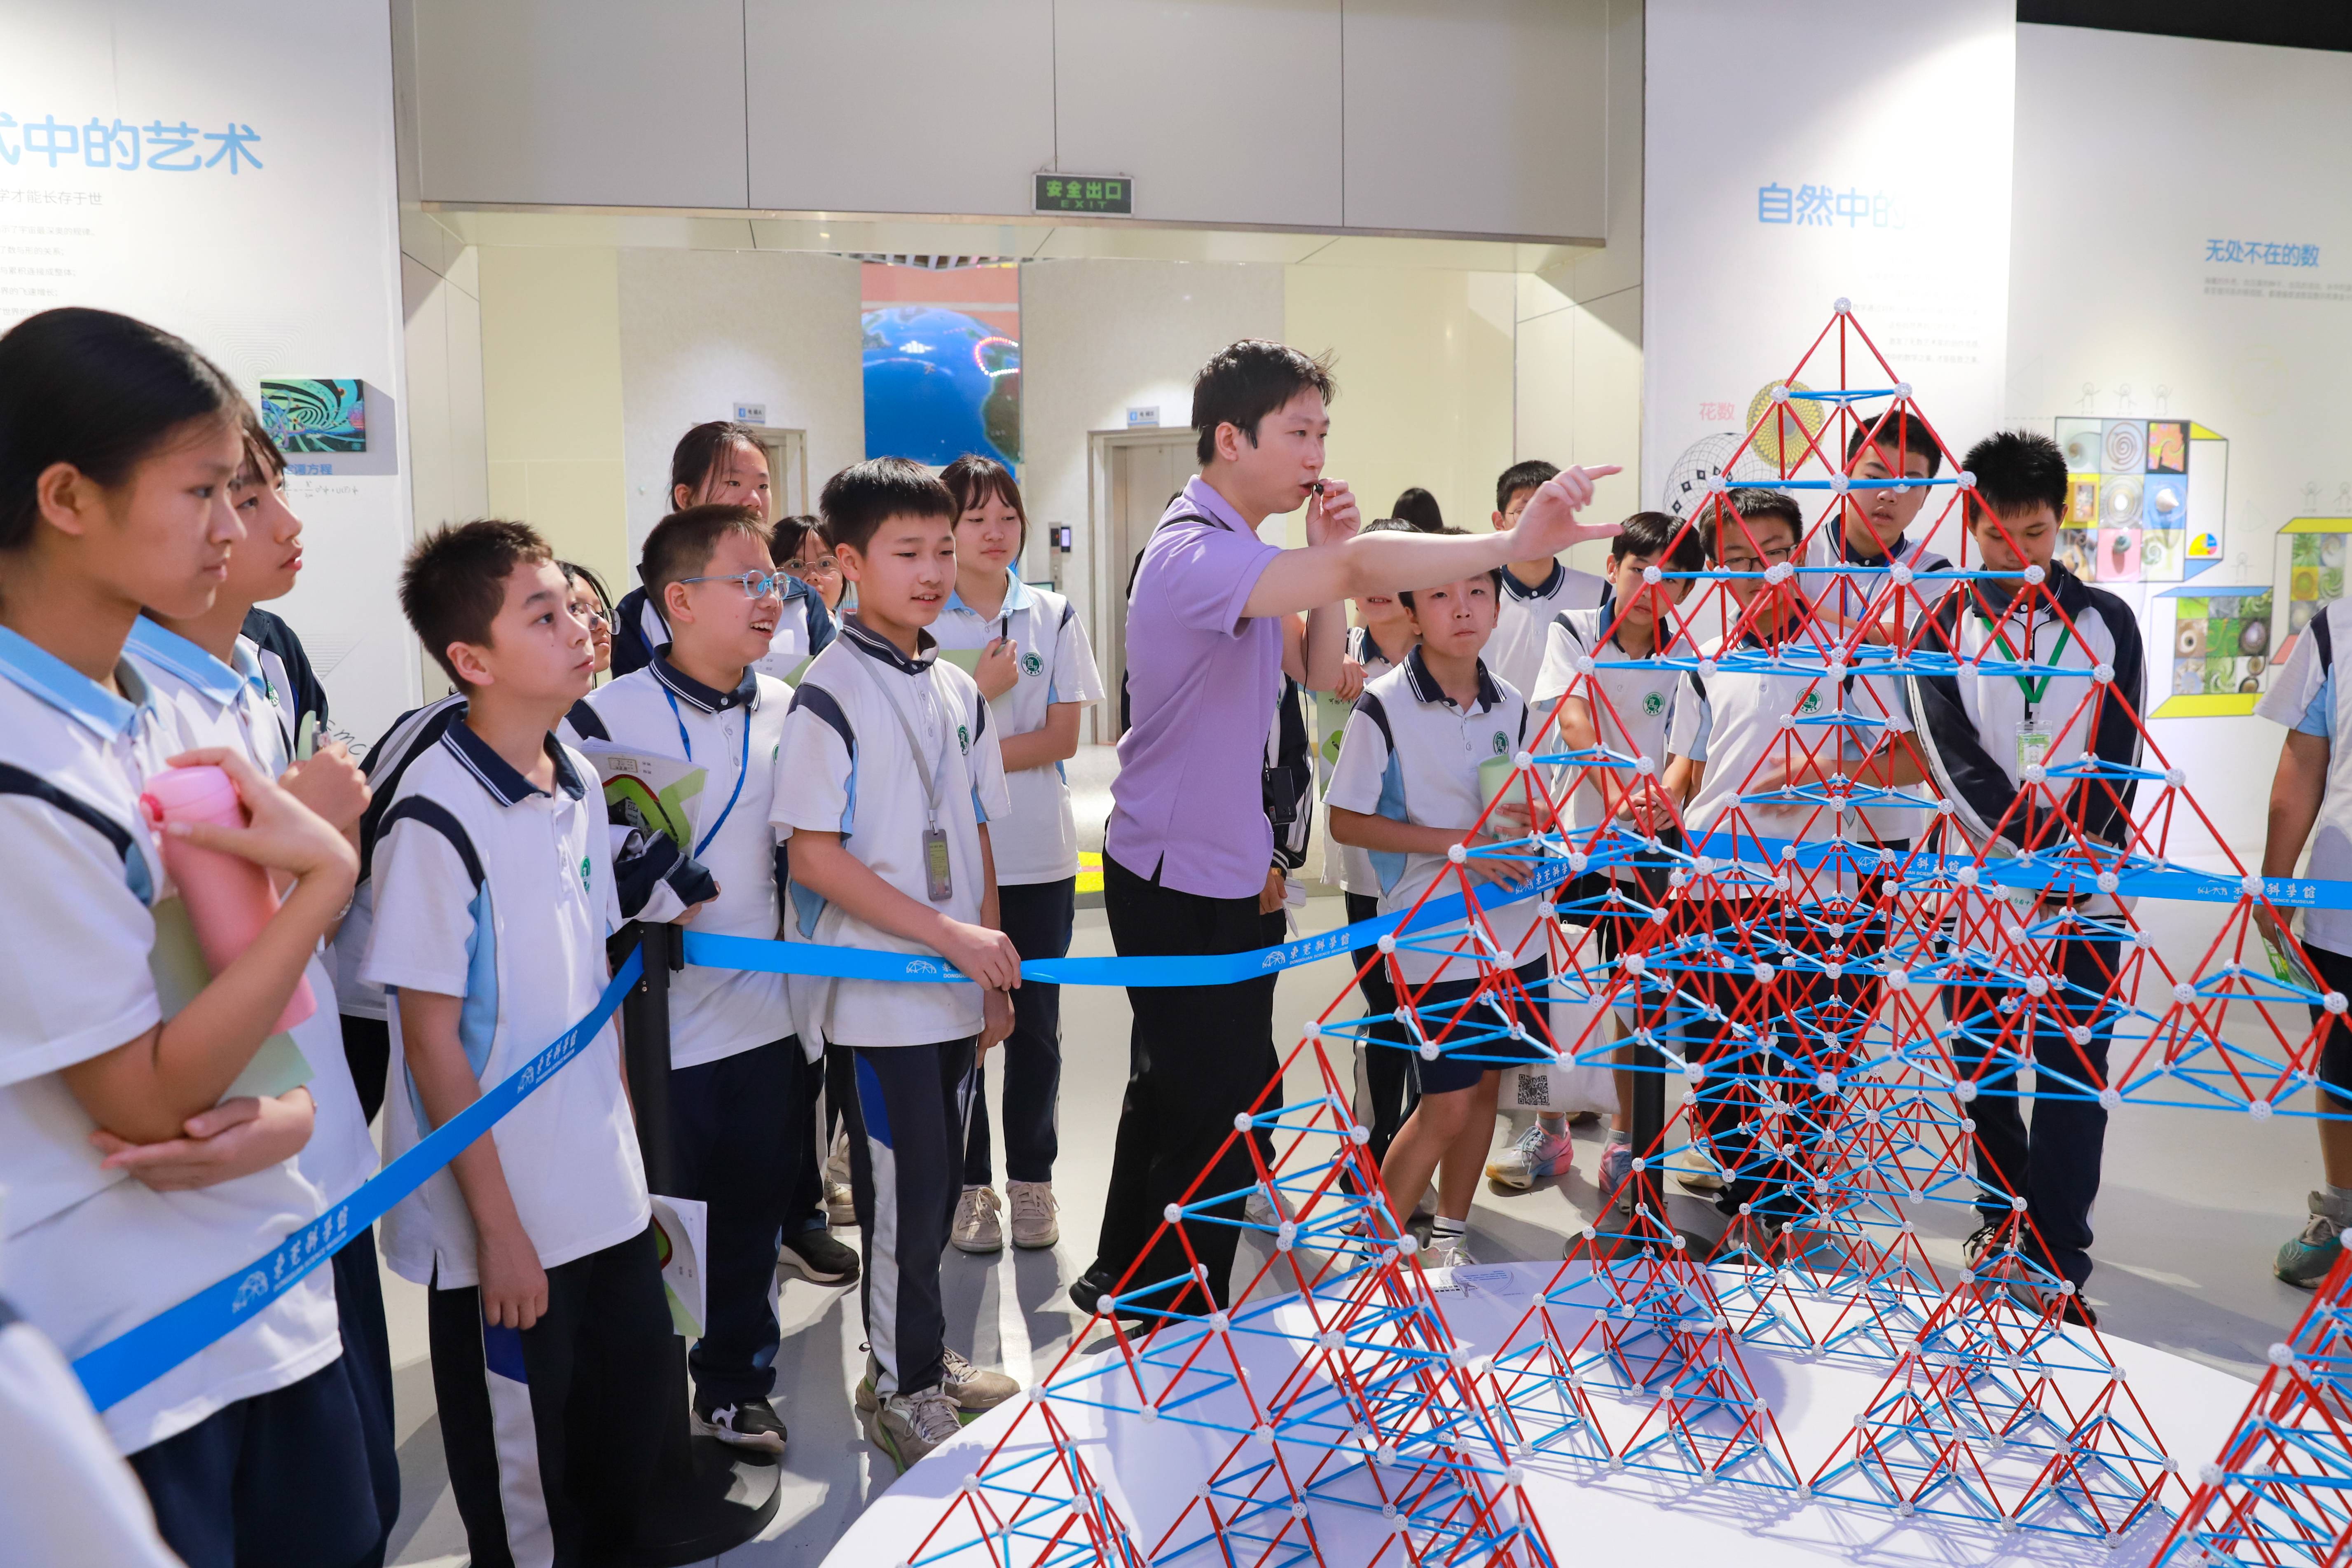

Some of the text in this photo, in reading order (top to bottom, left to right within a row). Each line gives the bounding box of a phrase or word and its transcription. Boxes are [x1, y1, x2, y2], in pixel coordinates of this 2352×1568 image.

[1046, 180, 1121, 200] 安全出口
[1061, 199, 1107, 209] EXIT
[2204, 238, 2320, 268] 无处不在的数
[1699, 402, 1735, 421] 花数
